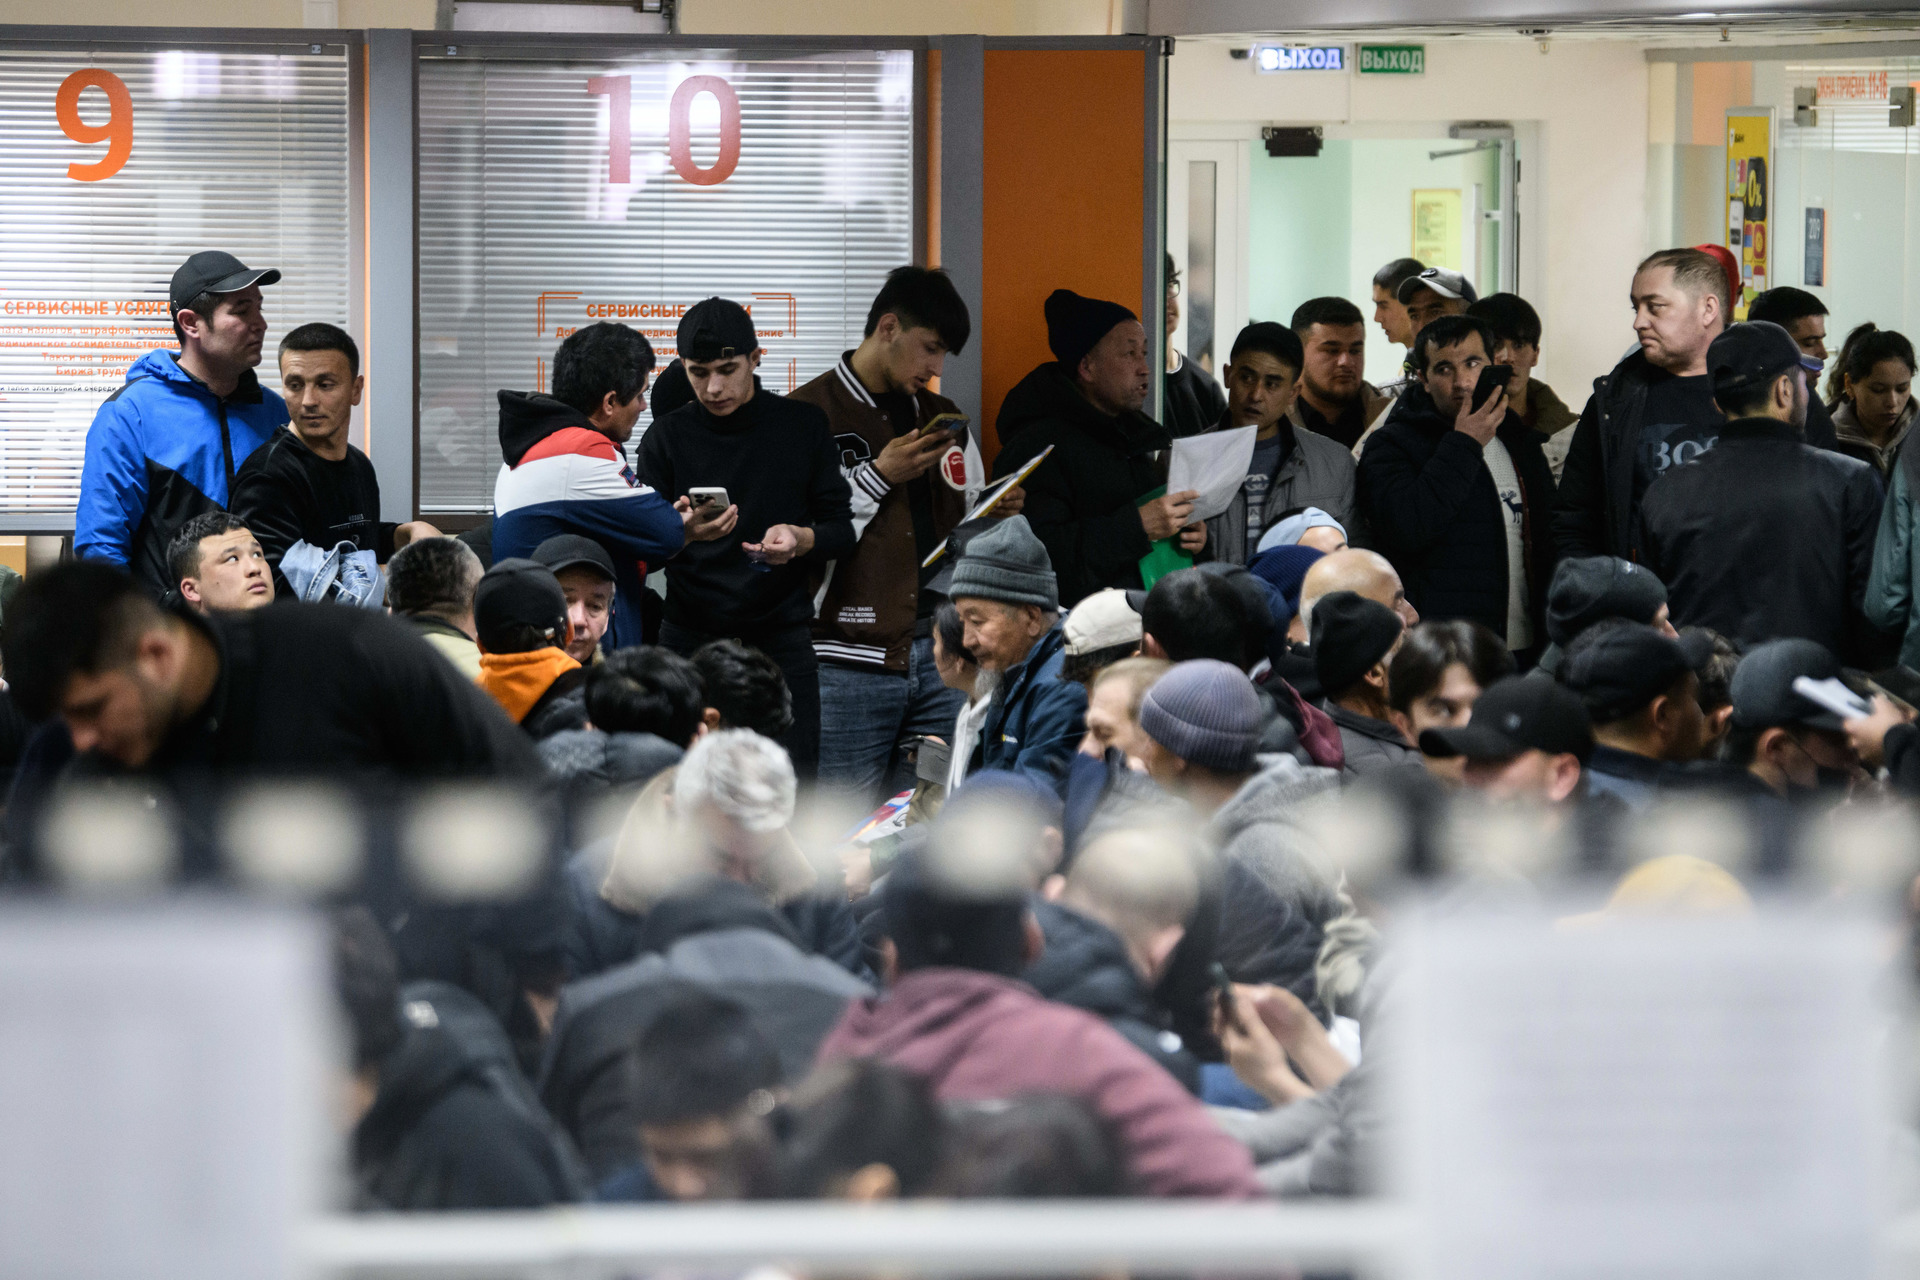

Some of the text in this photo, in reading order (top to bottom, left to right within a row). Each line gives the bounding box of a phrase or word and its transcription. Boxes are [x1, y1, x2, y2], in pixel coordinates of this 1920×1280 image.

[1262, 48, 1341, 70] ВЫХОД
[1362, 50, 1423, 72] ВЫХОД
[55, 68, 134, 182] 9
[587, 75, 741, 186] 10
[4, 301, 108, 315] СЕРВИСНЫЕ
[586, 304, 686, 318] СЕРВИСНЫЕ
[27, 326, 76, 336] налогов,
[80, 326, 134, 336] штрафов,
[70, 341, 181, 349] освидетельствован
[42, 352, 76, 361] Такси
[56, 365, 93, 376] Биржа
